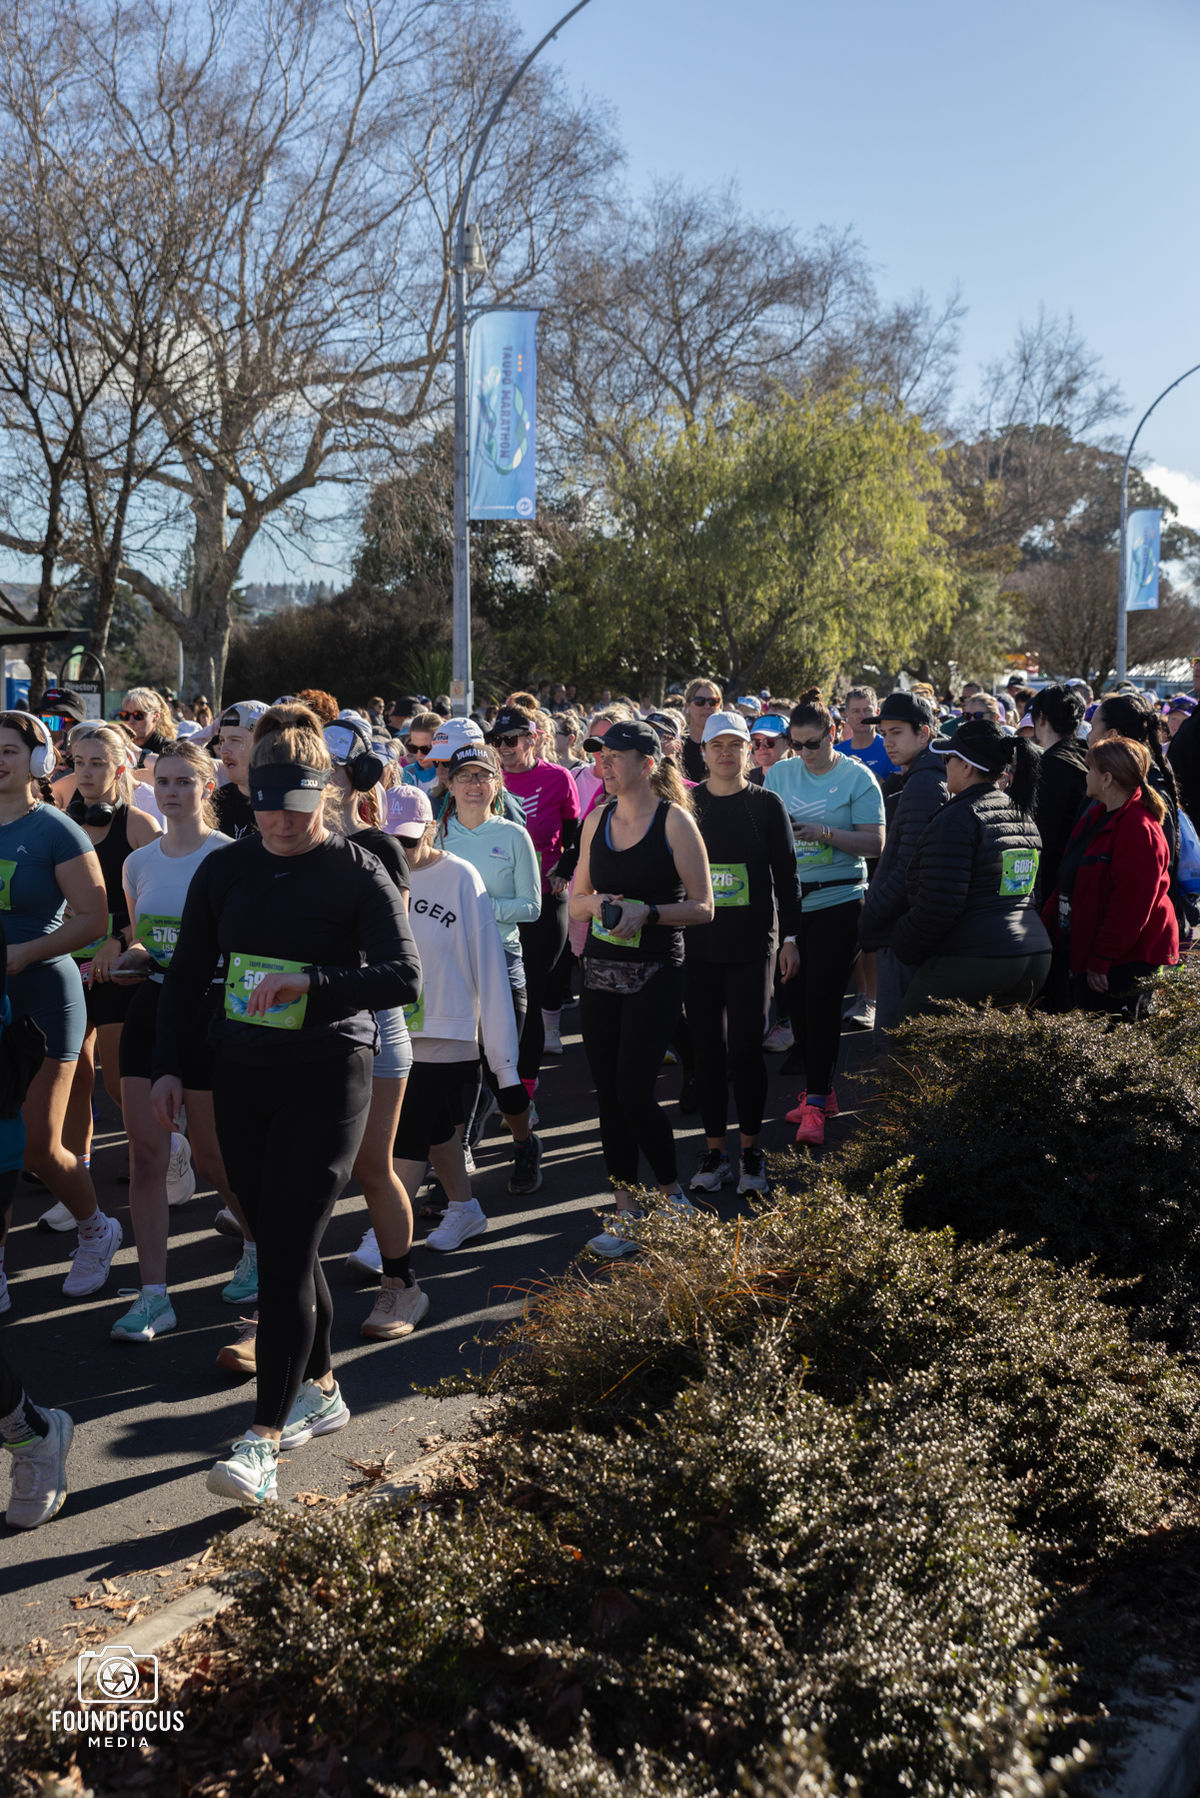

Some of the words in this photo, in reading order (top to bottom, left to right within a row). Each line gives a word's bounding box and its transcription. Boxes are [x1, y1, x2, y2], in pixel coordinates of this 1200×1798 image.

[499, 390, 511, 458] MARATHON
[456, 748, 489, 761] YAMAHA
[300, 779, 318, 787] 2XU
[390, 798, 404, 815] LA
